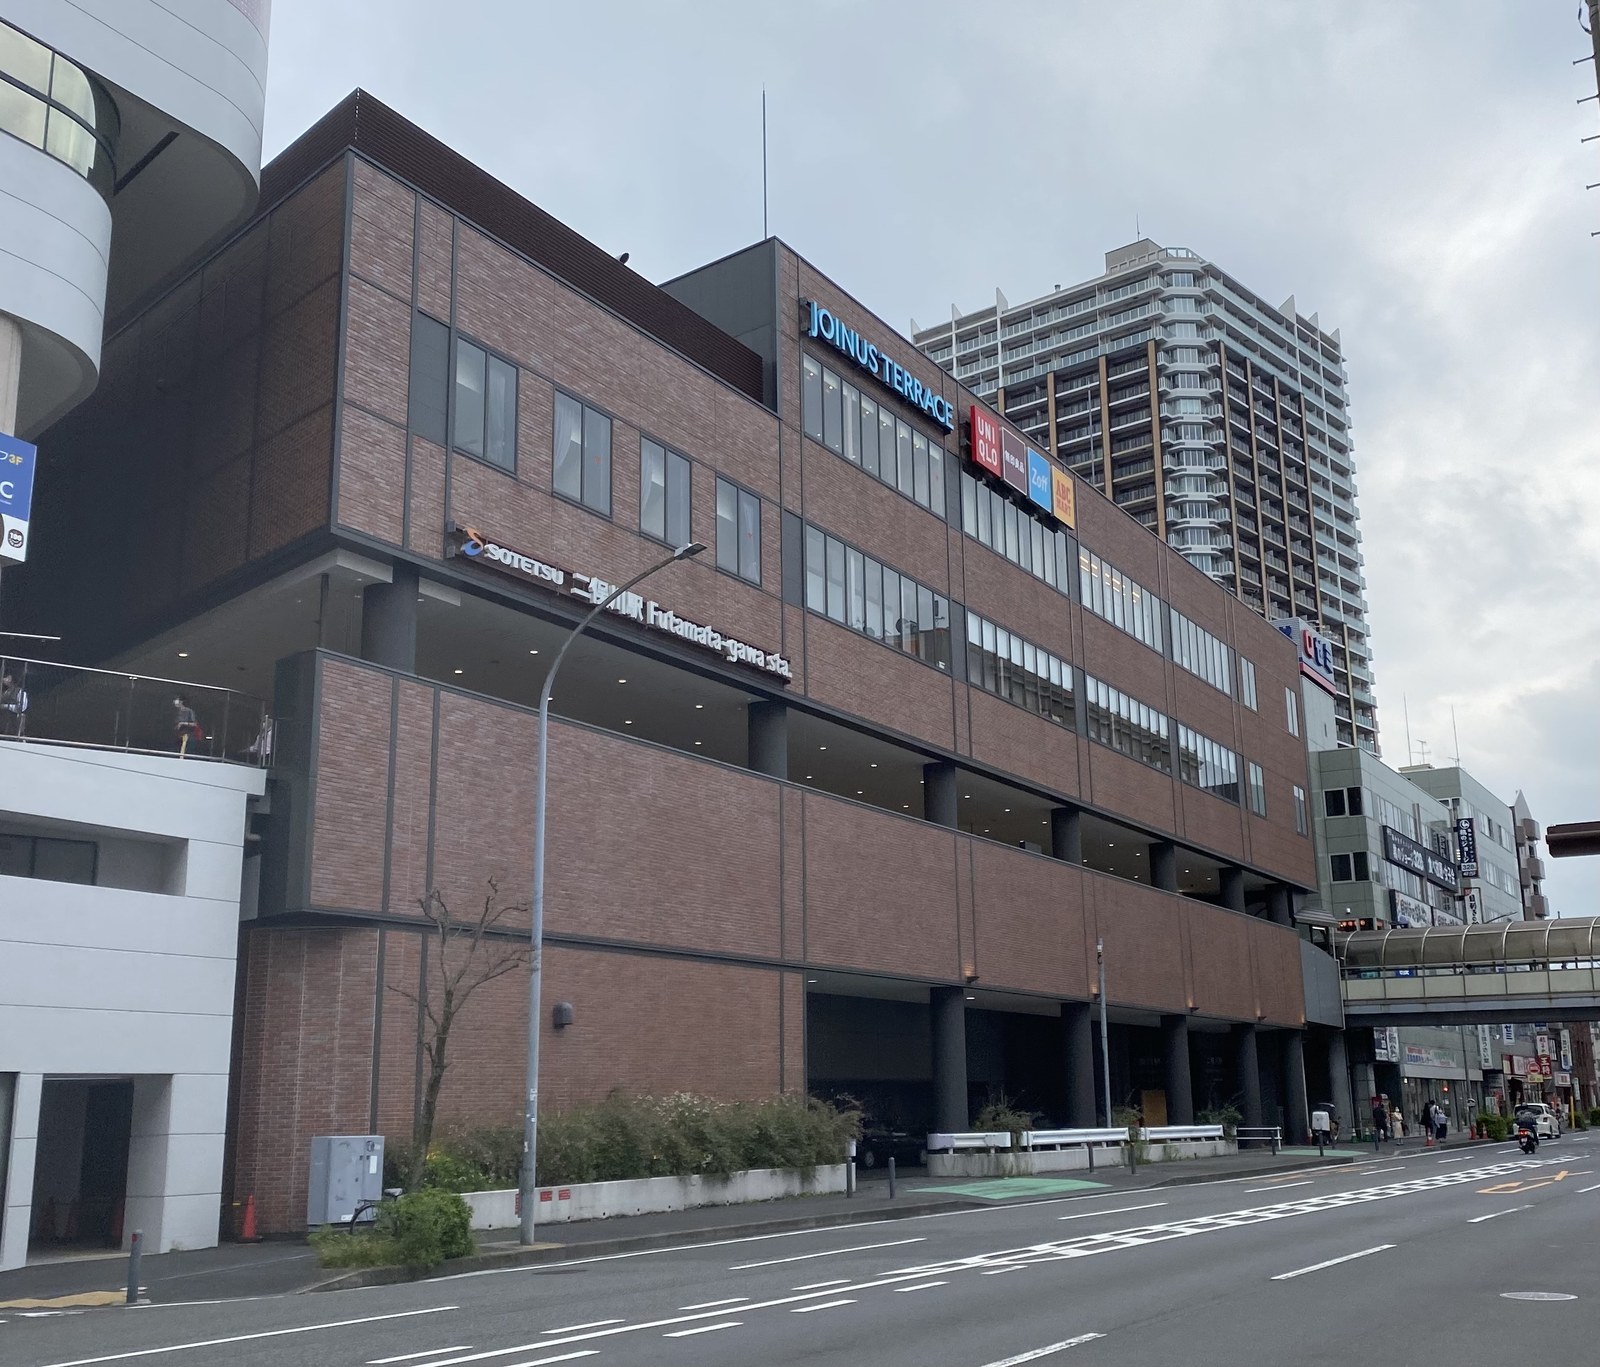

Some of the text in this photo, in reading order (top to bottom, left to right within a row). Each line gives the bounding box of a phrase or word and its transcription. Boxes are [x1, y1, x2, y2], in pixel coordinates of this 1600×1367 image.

[808, 300, 955, 432] JOINUS TERRACE
[977, 416, 996, 443] UNI
[8, 454, 23, 465] 3F
[979, 439, 998, 466] QLO
[1004, 450, 1025, 475] 無印良品
[1031, 468, 1048, 493] Zoff
[1056, 479, 1071, 504] ABC
[1056, 498, 1072, 518] MART
[485, 543, 565, 585] SOTETSU
[570, 573, 645, 622] 二俣川駅
[646, 600, 764, 668] Futamata-gawa
